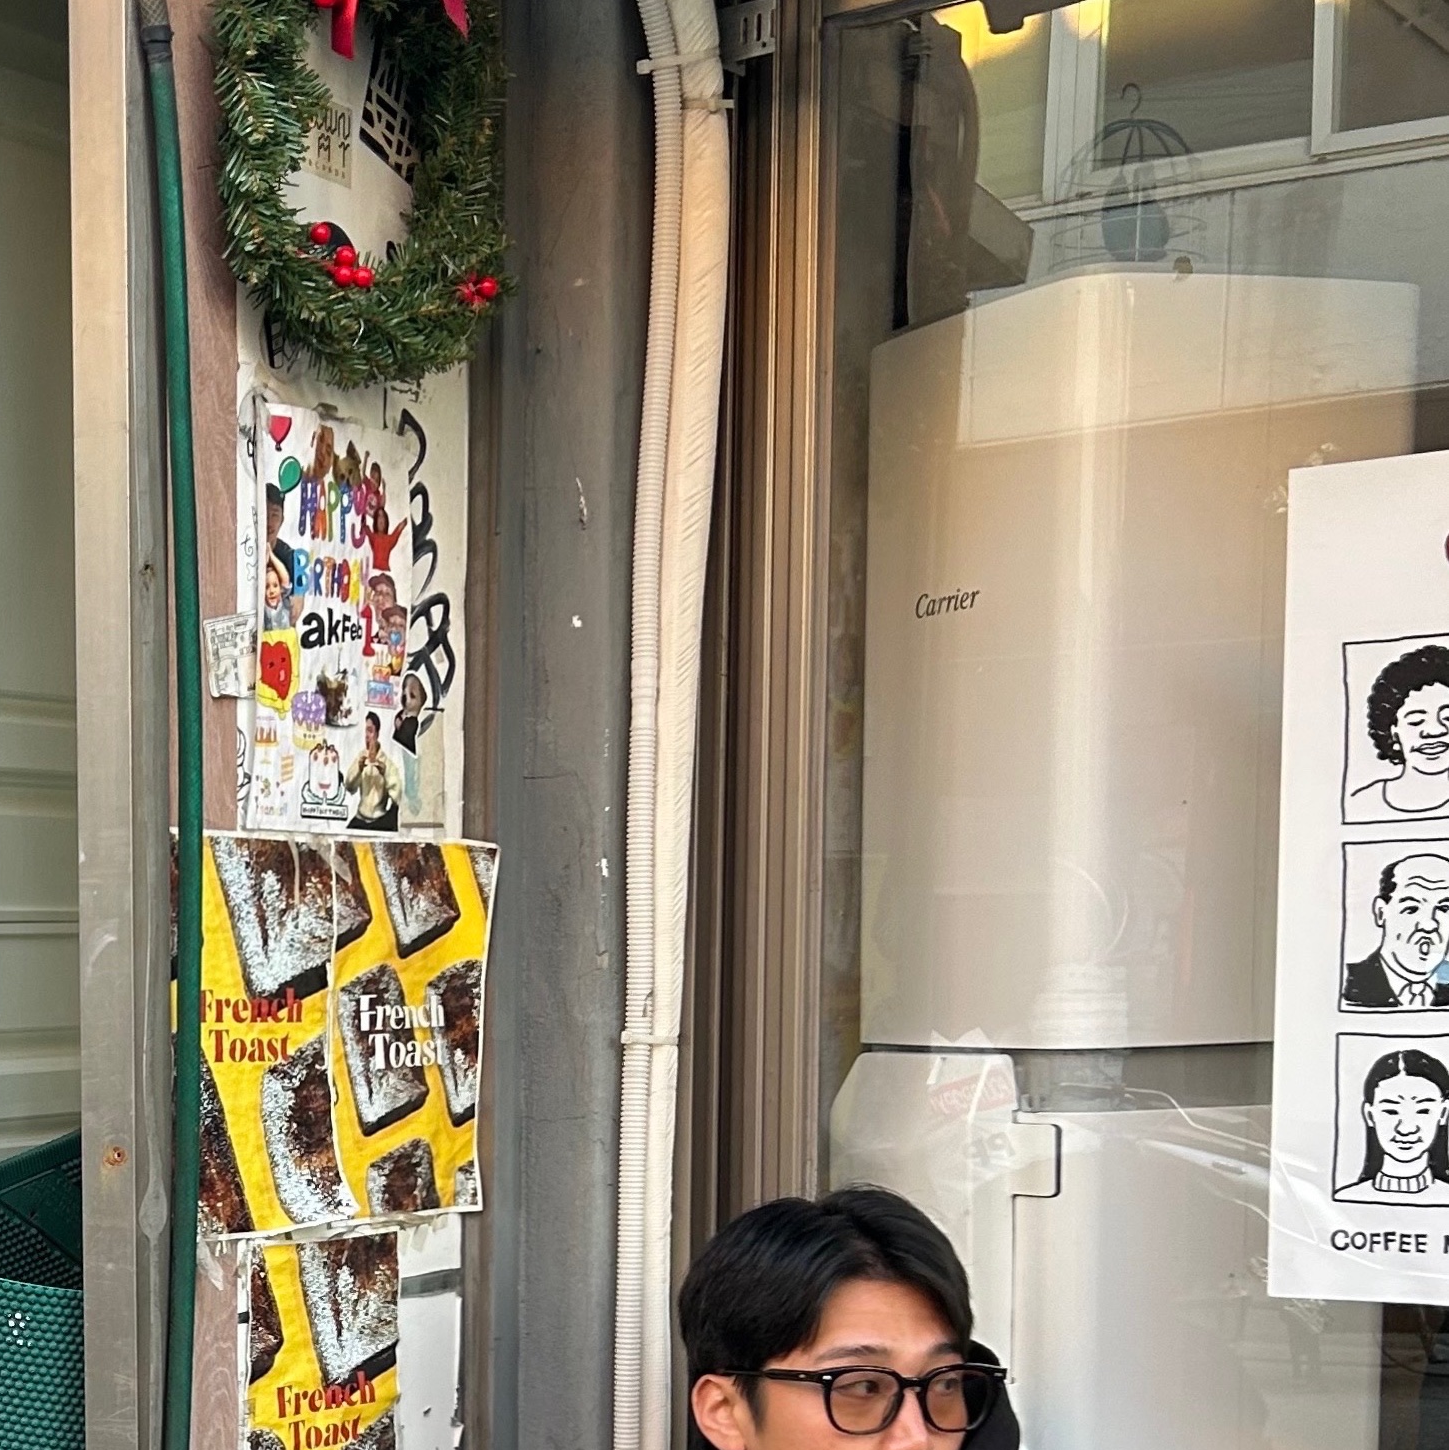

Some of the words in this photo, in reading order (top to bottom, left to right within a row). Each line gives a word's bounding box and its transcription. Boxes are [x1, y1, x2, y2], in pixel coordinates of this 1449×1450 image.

[298, 479, 367, 549] HAPPY
[915, 588, 980, 619] Carrier
[300, 607, 363, 650] akFeb
[200, 986, 303, 1024] French
[359, 994, 445, 1032] French
[208, 1029, 291, 1063] Toast
[368, 1033, 444, 1070] Toast
[1330, 1229, 1428, 1254] COFFEE
[276, 1370, 376, 1419] French
